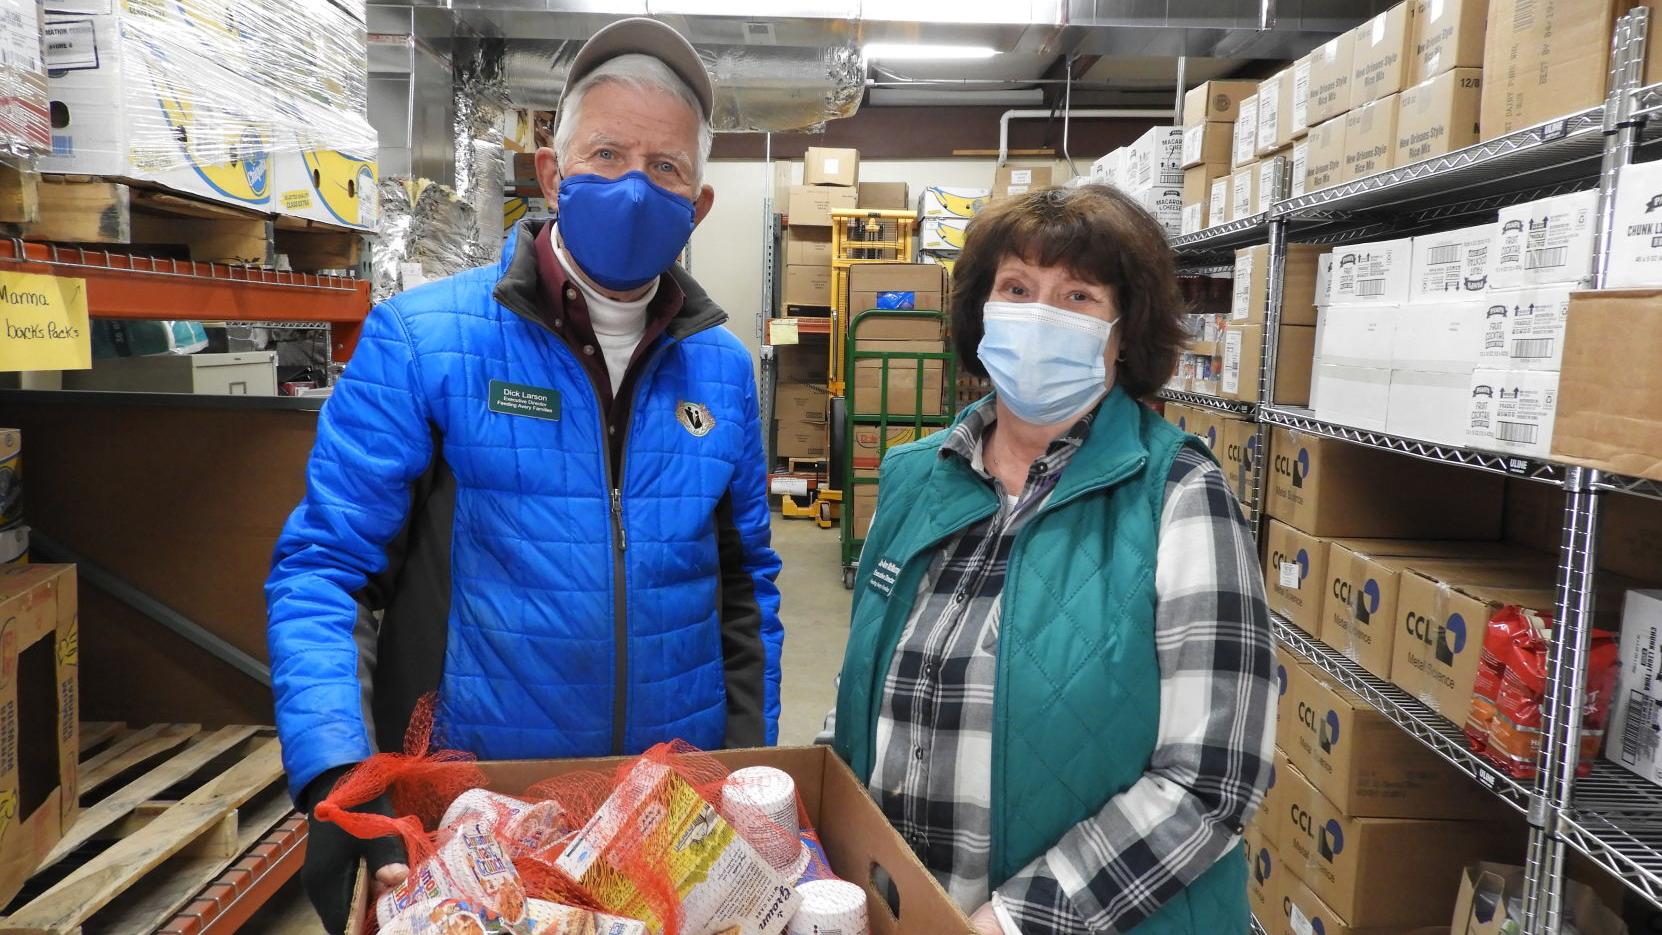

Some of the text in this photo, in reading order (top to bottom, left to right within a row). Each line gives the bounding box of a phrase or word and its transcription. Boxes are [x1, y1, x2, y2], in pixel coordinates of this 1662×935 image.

[503, 396, 528, 404] Executive
[504, 388, 547, 401] Dick Larson
[497, 400, 518, 409] Feeding
[532, 405, 553, 413] Families
[1228, 444, 1242, 463] CCL
[1274, 454, 1291, 477] CCL
[1406, 611, 1432, 646] CCL
[1407, 652, 1426, 670] Metal
[1298, 701, 1317, 734] CCL
[1290, 803, 1315, 840] CCL
